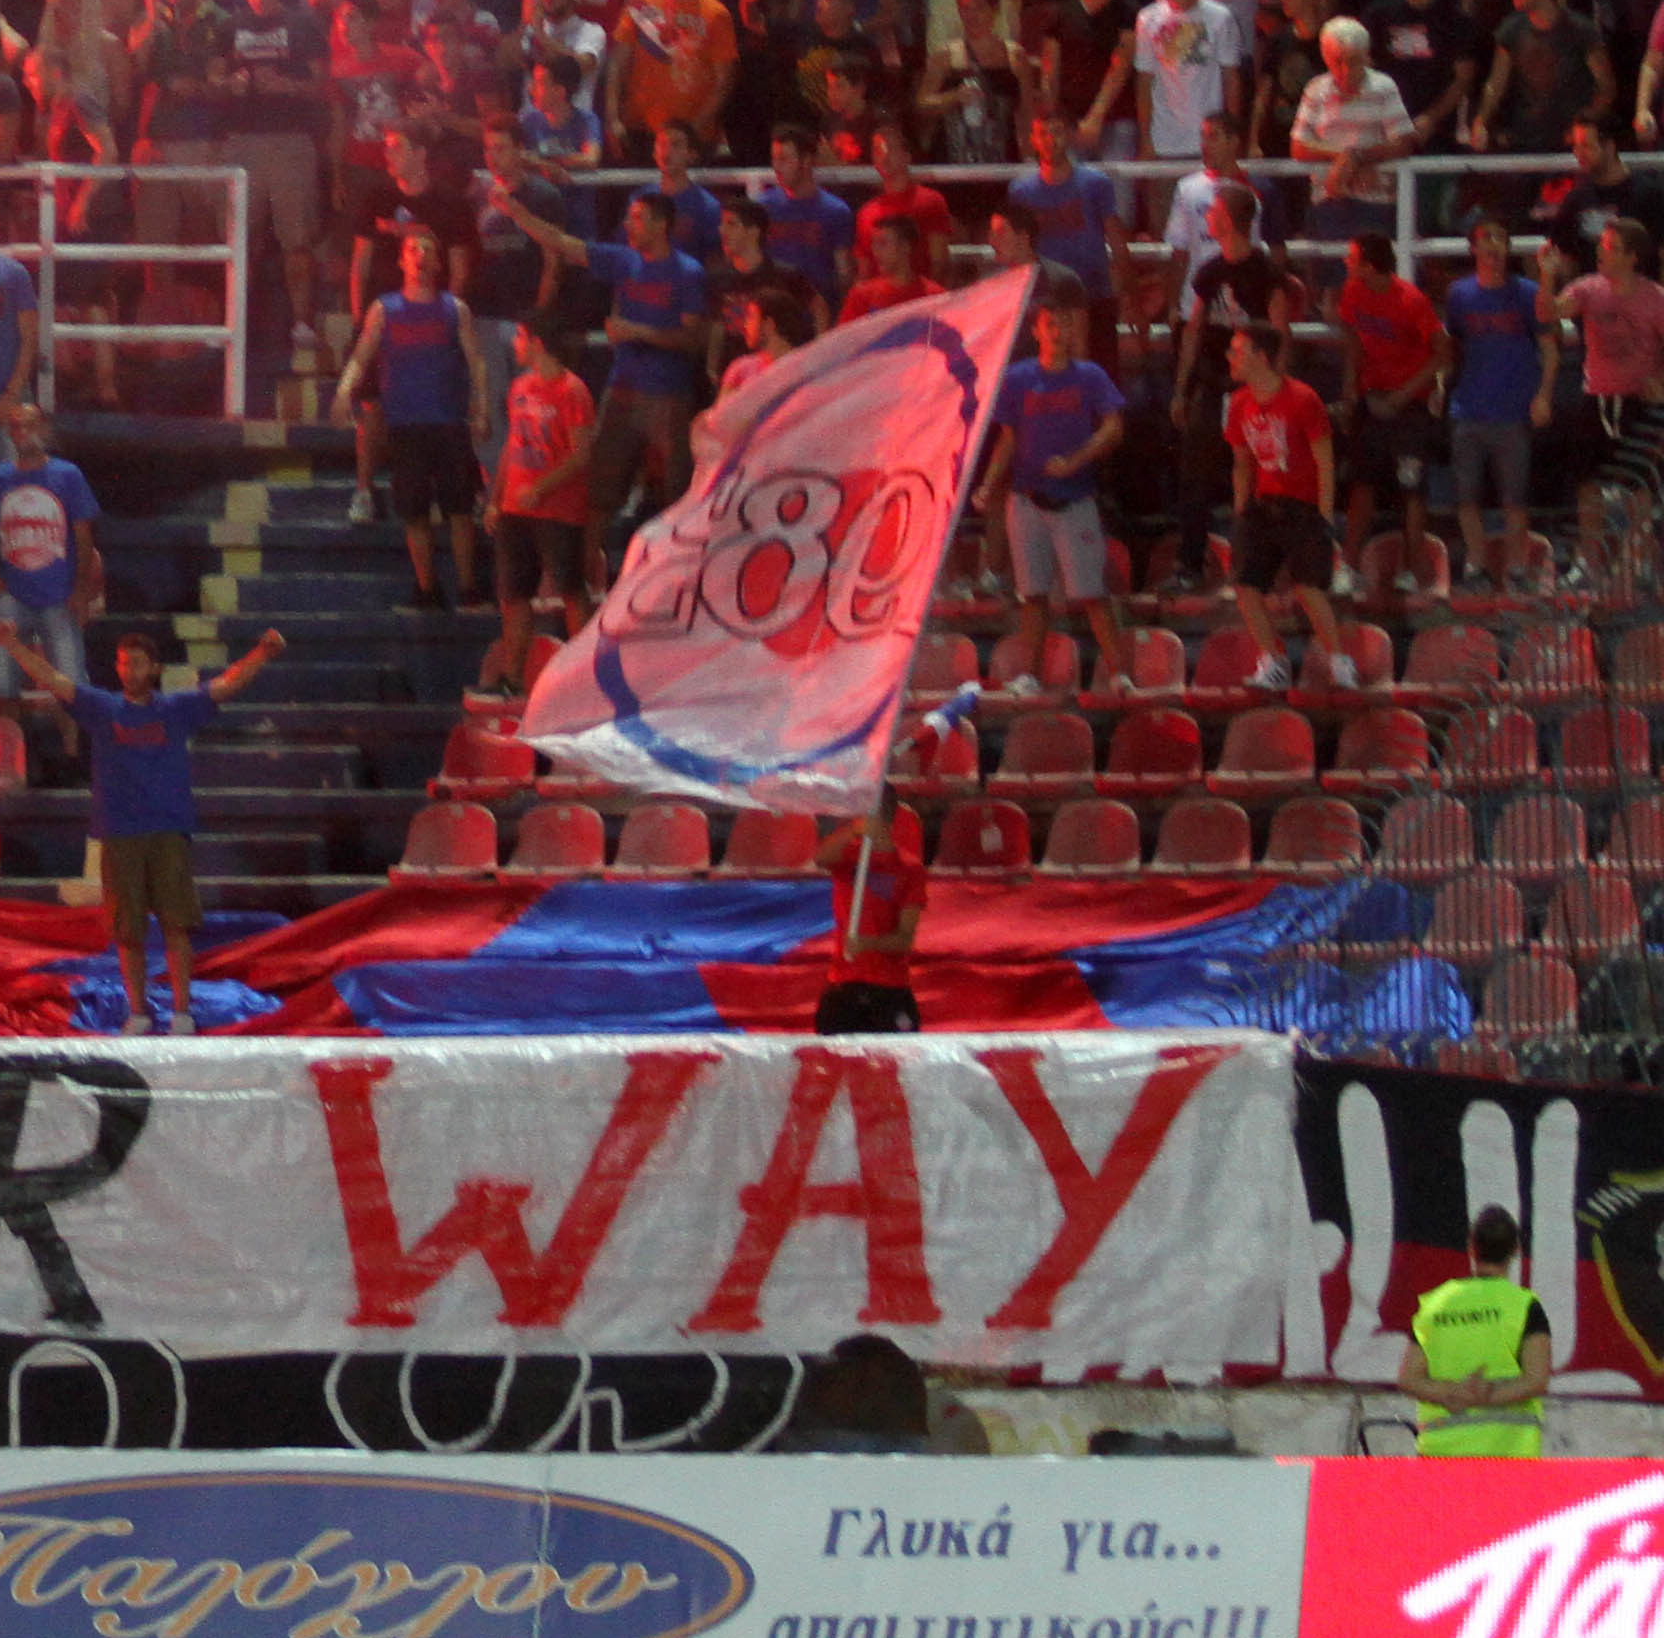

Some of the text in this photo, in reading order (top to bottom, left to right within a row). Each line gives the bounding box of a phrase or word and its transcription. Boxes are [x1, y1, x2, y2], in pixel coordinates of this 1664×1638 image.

[309, 1044, 1241, 1334] WAY
[1432, 1307, 1501, 1327] SECURITY
[822, 1503, 1221, 1573] Γλυκά για...
